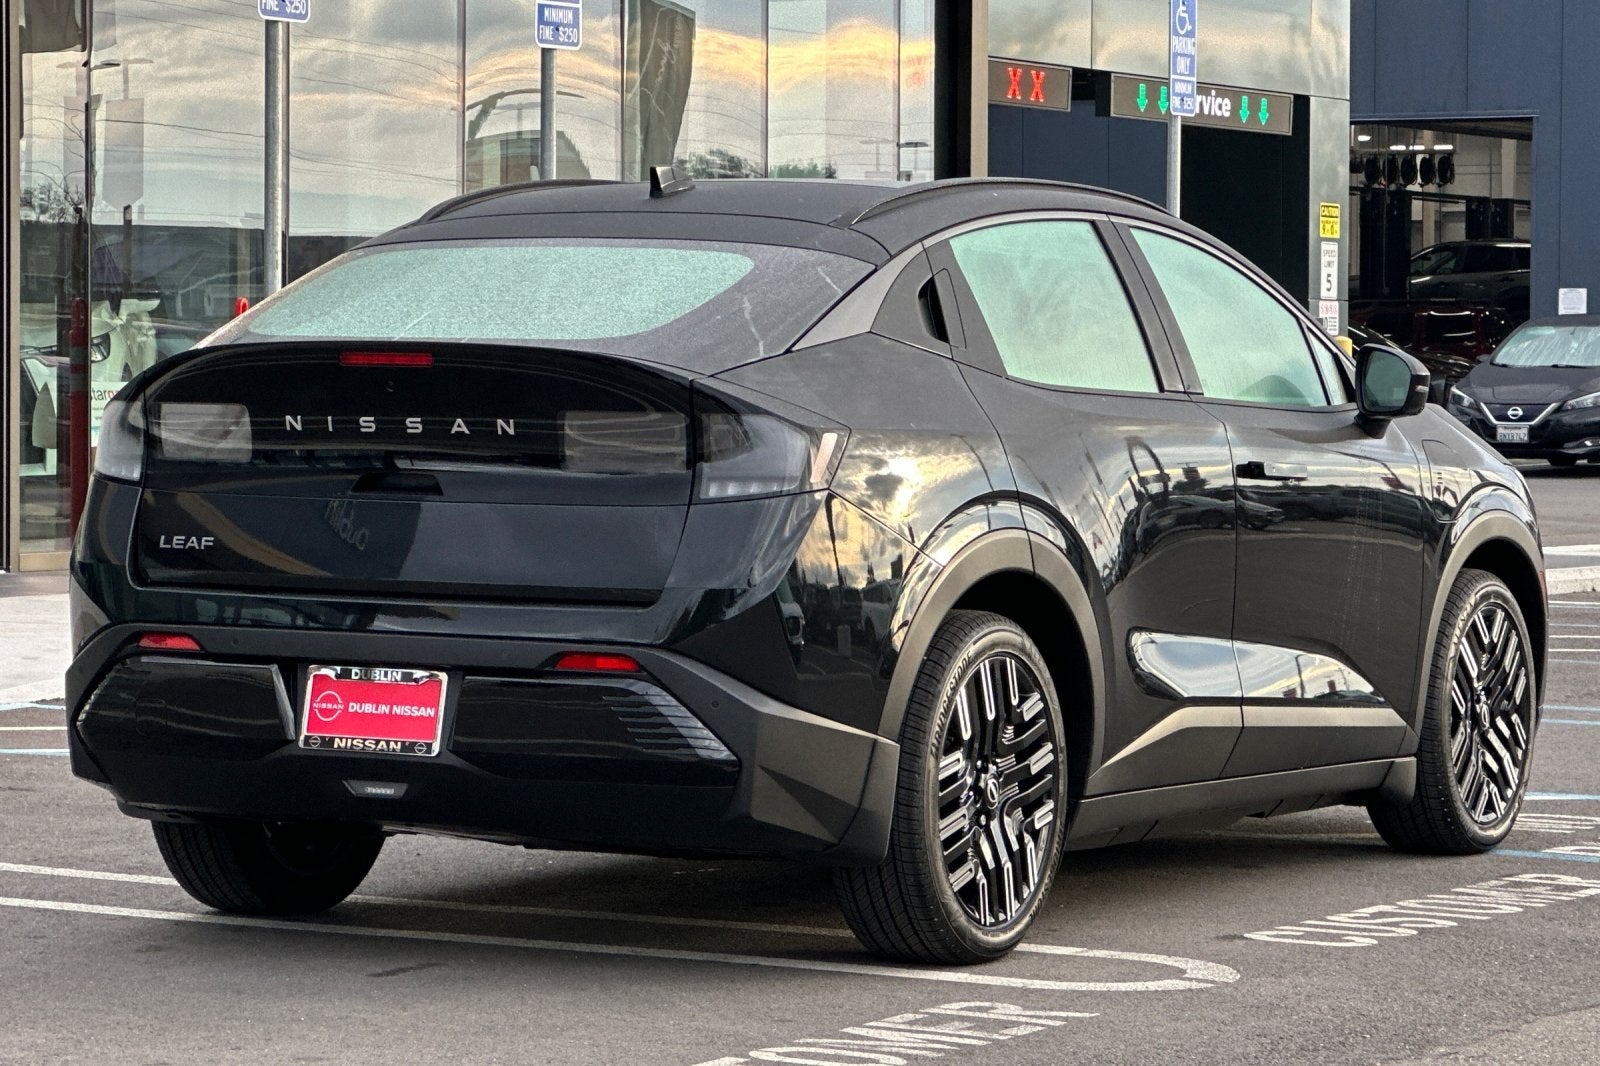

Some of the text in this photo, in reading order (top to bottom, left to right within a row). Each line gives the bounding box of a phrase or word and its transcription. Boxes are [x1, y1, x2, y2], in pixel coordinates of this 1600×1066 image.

[261, 0, 306, 15] FINE $250
[544, 7, 573, 24] MINIMUM
[540, 25, 578, 43] FINE $250
[1172, 36, 1195, 55] PARKING
[1176, 56, 1191, 75] ONLY
[1196, 90, 1231, 117] rvice
[1323, 250, 1336, 258] SPEED
[1326, 273, 1333, 292] 5
[285, 415, 515, 436] NISSAN
[159, 534, 214, 550] LEAF
[351, 668, 401, 682] DUBLIN
[313, 702, 344, 710] NISSAN
[348, 702, 435, 718] DUBLIN NISSAN
[333, 737, 401, 753] NISSAN
[1244, 873, 1600, 946] CUSTOMER
